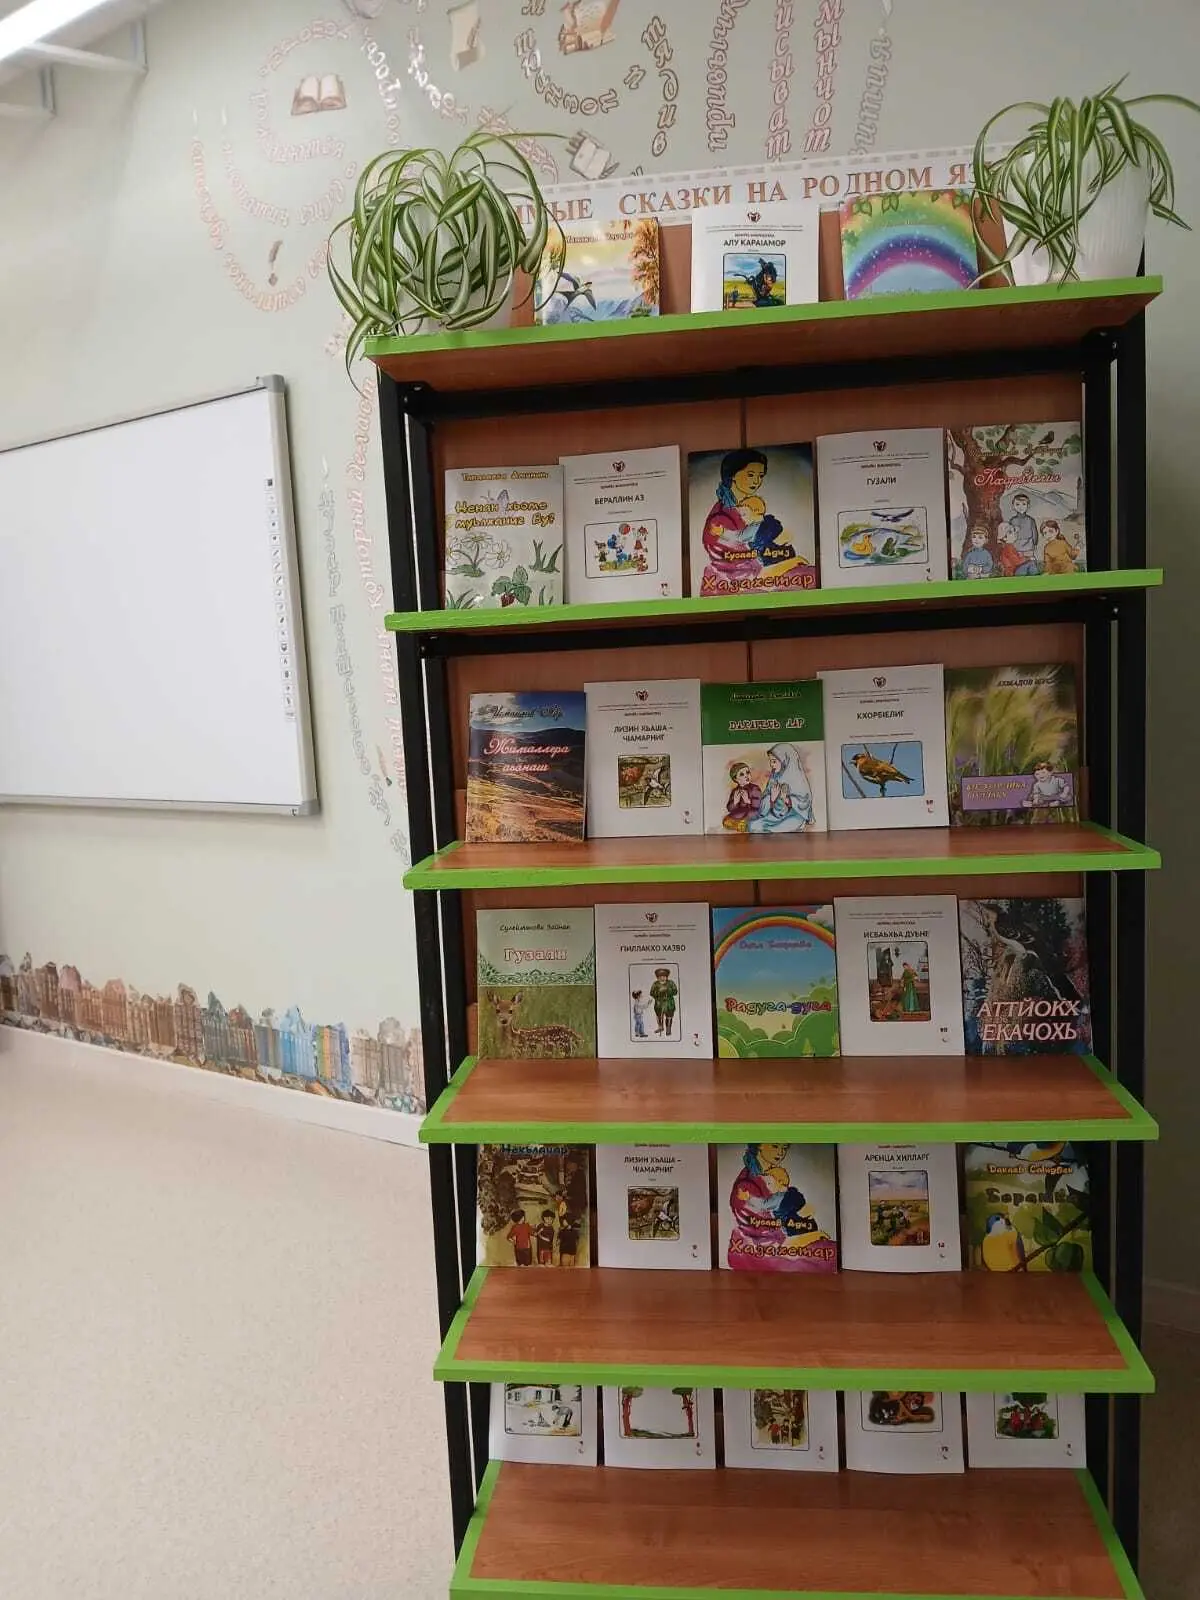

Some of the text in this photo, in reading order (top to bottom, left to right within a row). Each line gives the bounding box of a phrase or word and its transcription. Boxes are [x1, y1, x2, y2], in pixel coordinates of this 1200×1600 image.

[618, 185, 732, 215] СКАЗКИ
[747, 180, 788, 203] НА
[801, 166, 933, 199] РОДНОМ
[866, 477, 897, 486] ГУЗАЛИ
